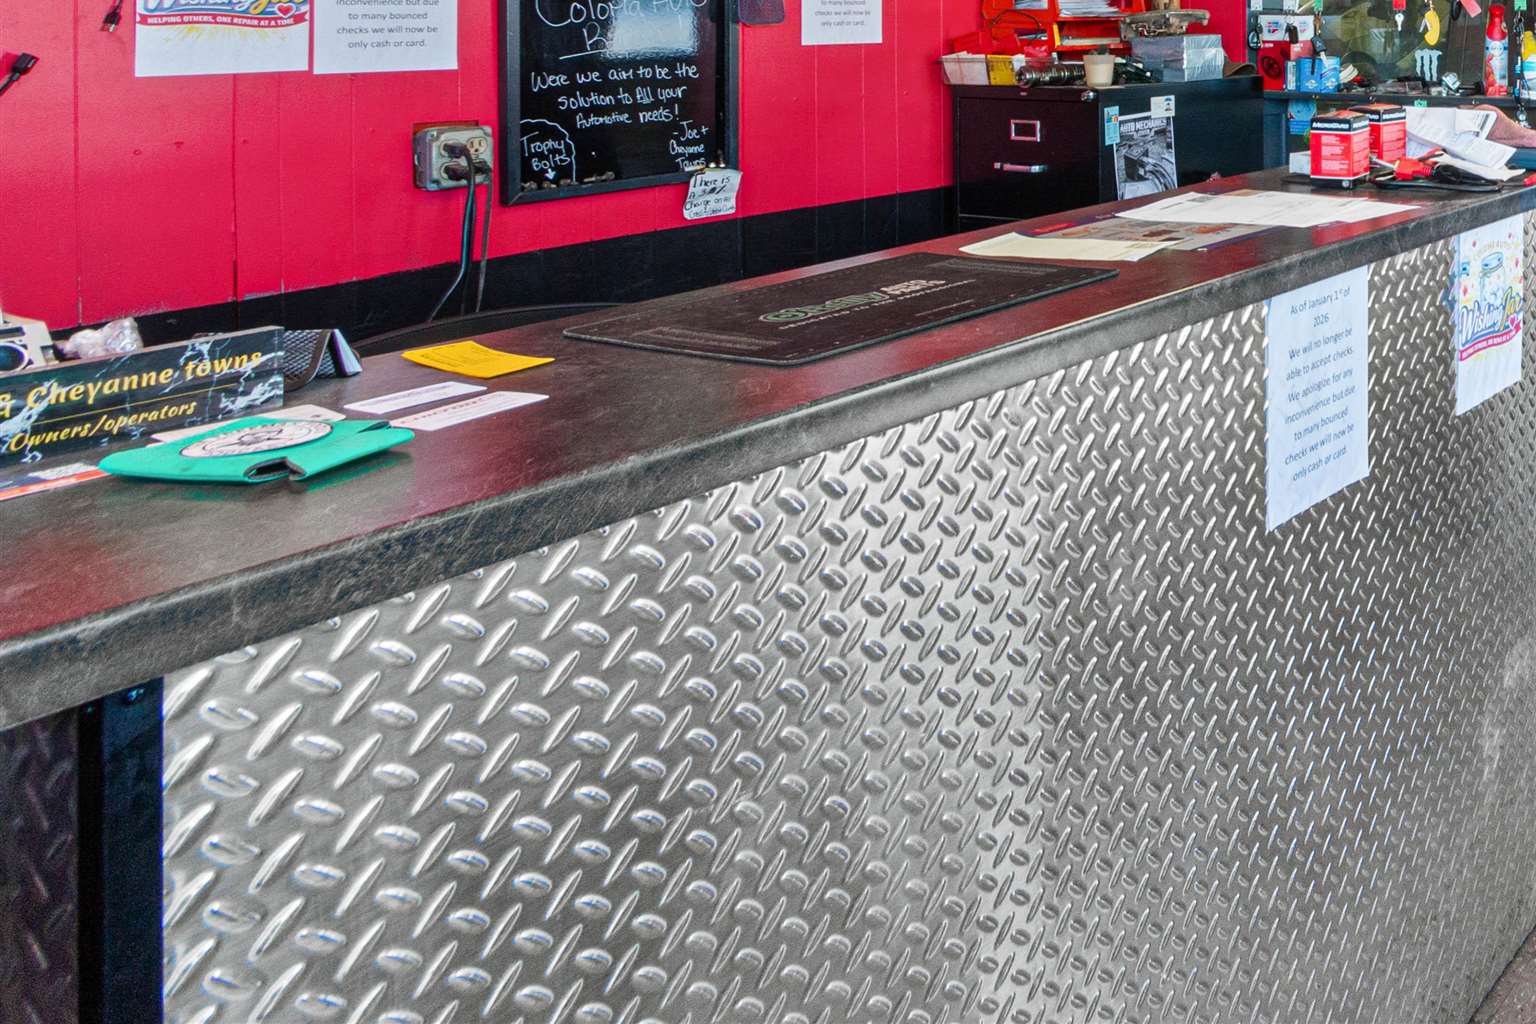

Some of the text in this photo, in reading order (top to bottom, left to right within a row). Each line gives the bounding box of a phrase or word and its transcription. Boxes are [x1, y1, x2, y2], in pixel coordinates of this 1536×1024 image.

[147, 16, 182, 24] HELPING
[348, 12, 429, 22] to many bounced
[336, 26, 369, 35] checks
[387, 26, 403, 34] will
[405, 26, 425, 34] now
[426, 25, 439, 34] be
[348, 39, 369, 50] only
[370, 39, 392, 48] cash
[393, 40, 404, 48] or
[531, 70, 570, 92] Were
[576, 70, 602, 83] we
[636, 66, 653, 79] to
[655, 64, 672, 80] be
[675, 62, 700, 79] the
[558, 87, 616, 110] solution
[616, 87, 634, 105] to
[657, 85, 688, 106] your
[576, 104, 679, 130] Automotive needs!
[520, 130, 566, 158] Trophy
[531, 154, 572, 172] Bolts
[1290, 304, 1298, 316] As
[1298, 300, 1307, 312] of
[1313, 312, 1330, 328] 2026
[1288, 346, 1300, 360] We
[1322, 331, 1344, 345] longer
[1302, 365, 1310, 375] to
[26, 367, 173, 409] Cheyanne
[1288, 391, 1300, 403] We
[1332, 372, 1340, 384] for
[8, 400, 197, 454] Owners/operators
[1293, 431, 1302, 441] to
[1284, 447, 1309, 466] checks
[1320, 432, 1332, 446] will
[1307, 458, 1324, 473] cash
